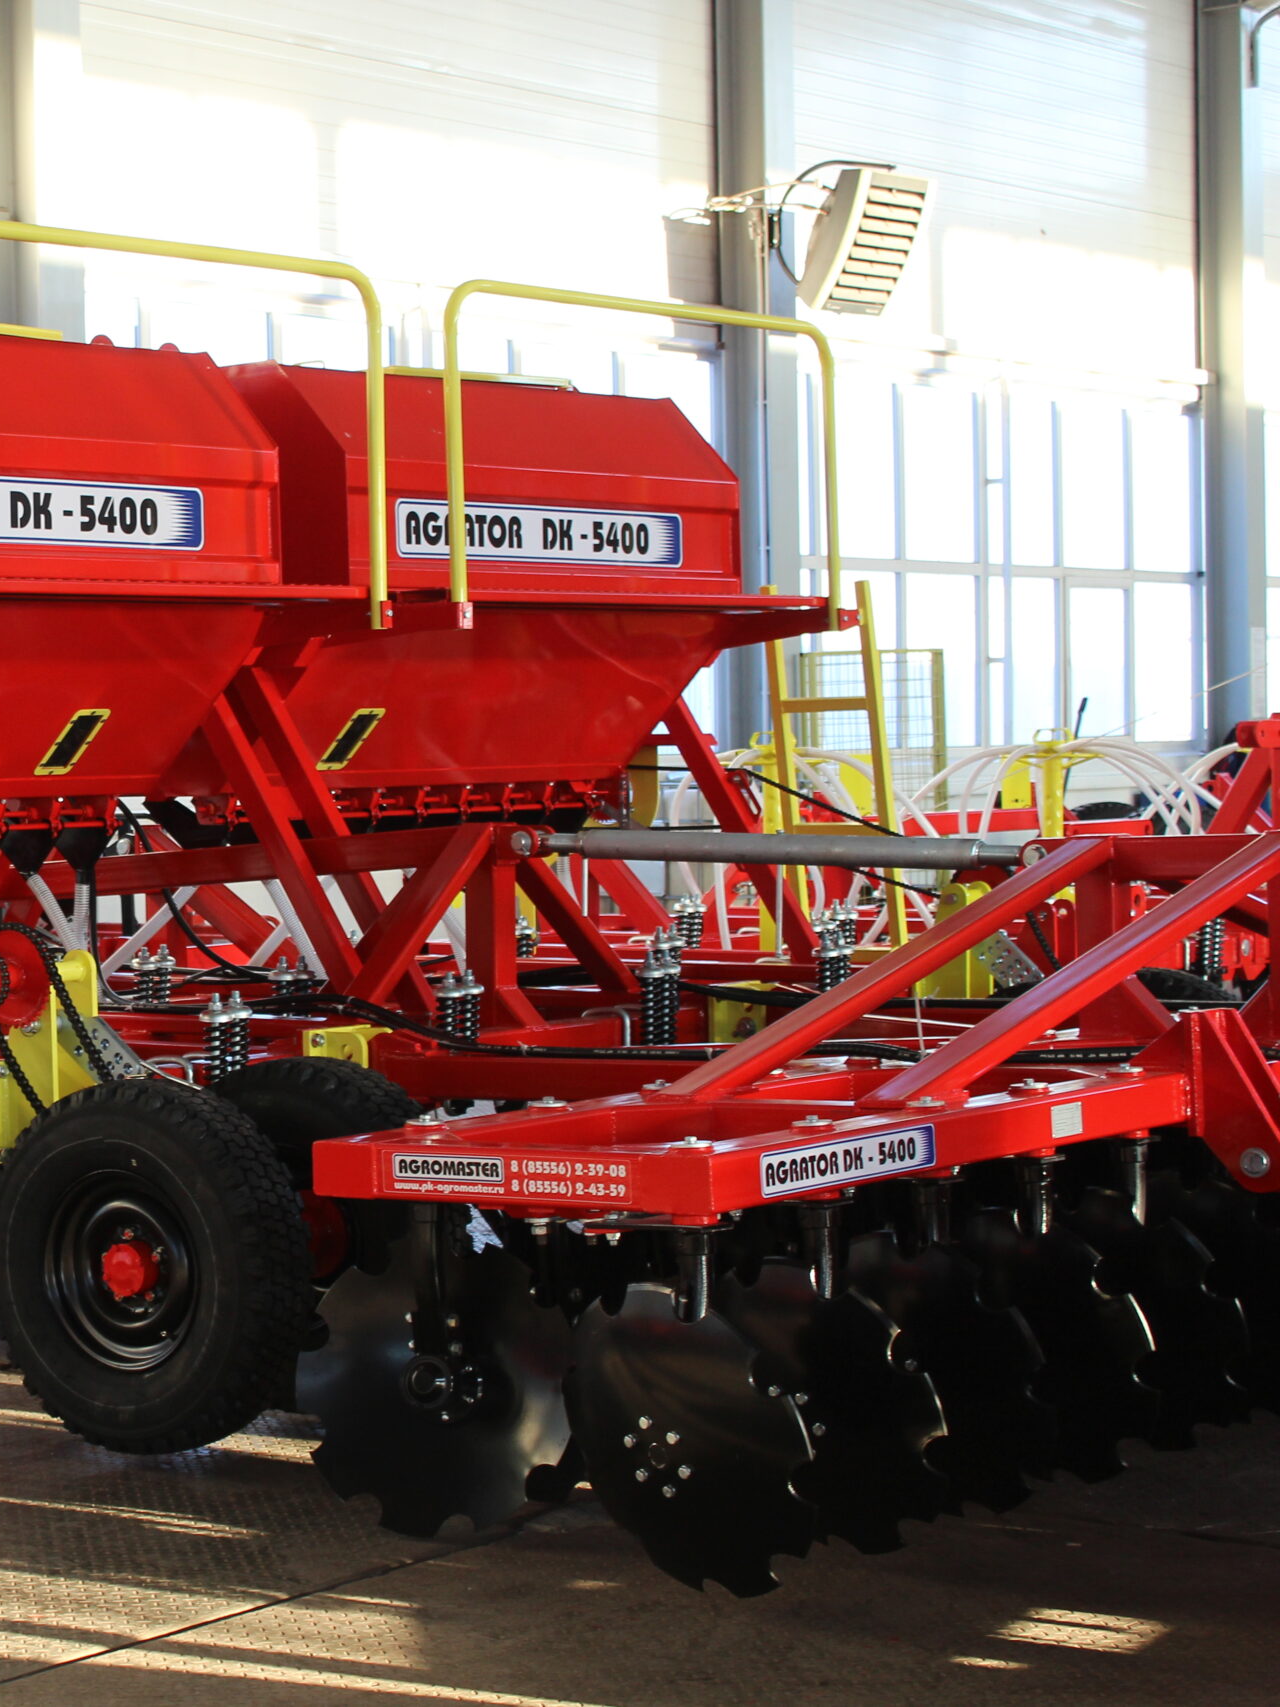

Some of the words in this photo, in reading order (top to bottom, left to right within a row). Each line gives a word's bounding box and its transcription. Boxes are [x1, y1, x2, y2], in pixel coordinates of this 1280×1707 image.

[399, 1159, 499, 1178] AGROMASTER
[510, 1160, 518, 1172] 8
[522, 1160, 571, 1177] (85556)
[575, 1163, 626, 1177] 2-39-08
[766, 1151, 839, 1187] AGRATOR
[394, 1182, 504, 1194] www.pk-agromaster.ru
[511, 1179, 519, 1191] 8
[523, 1179, 572, 1197] (85556)
[576, 1182, 625, 1197] 2-43-59
